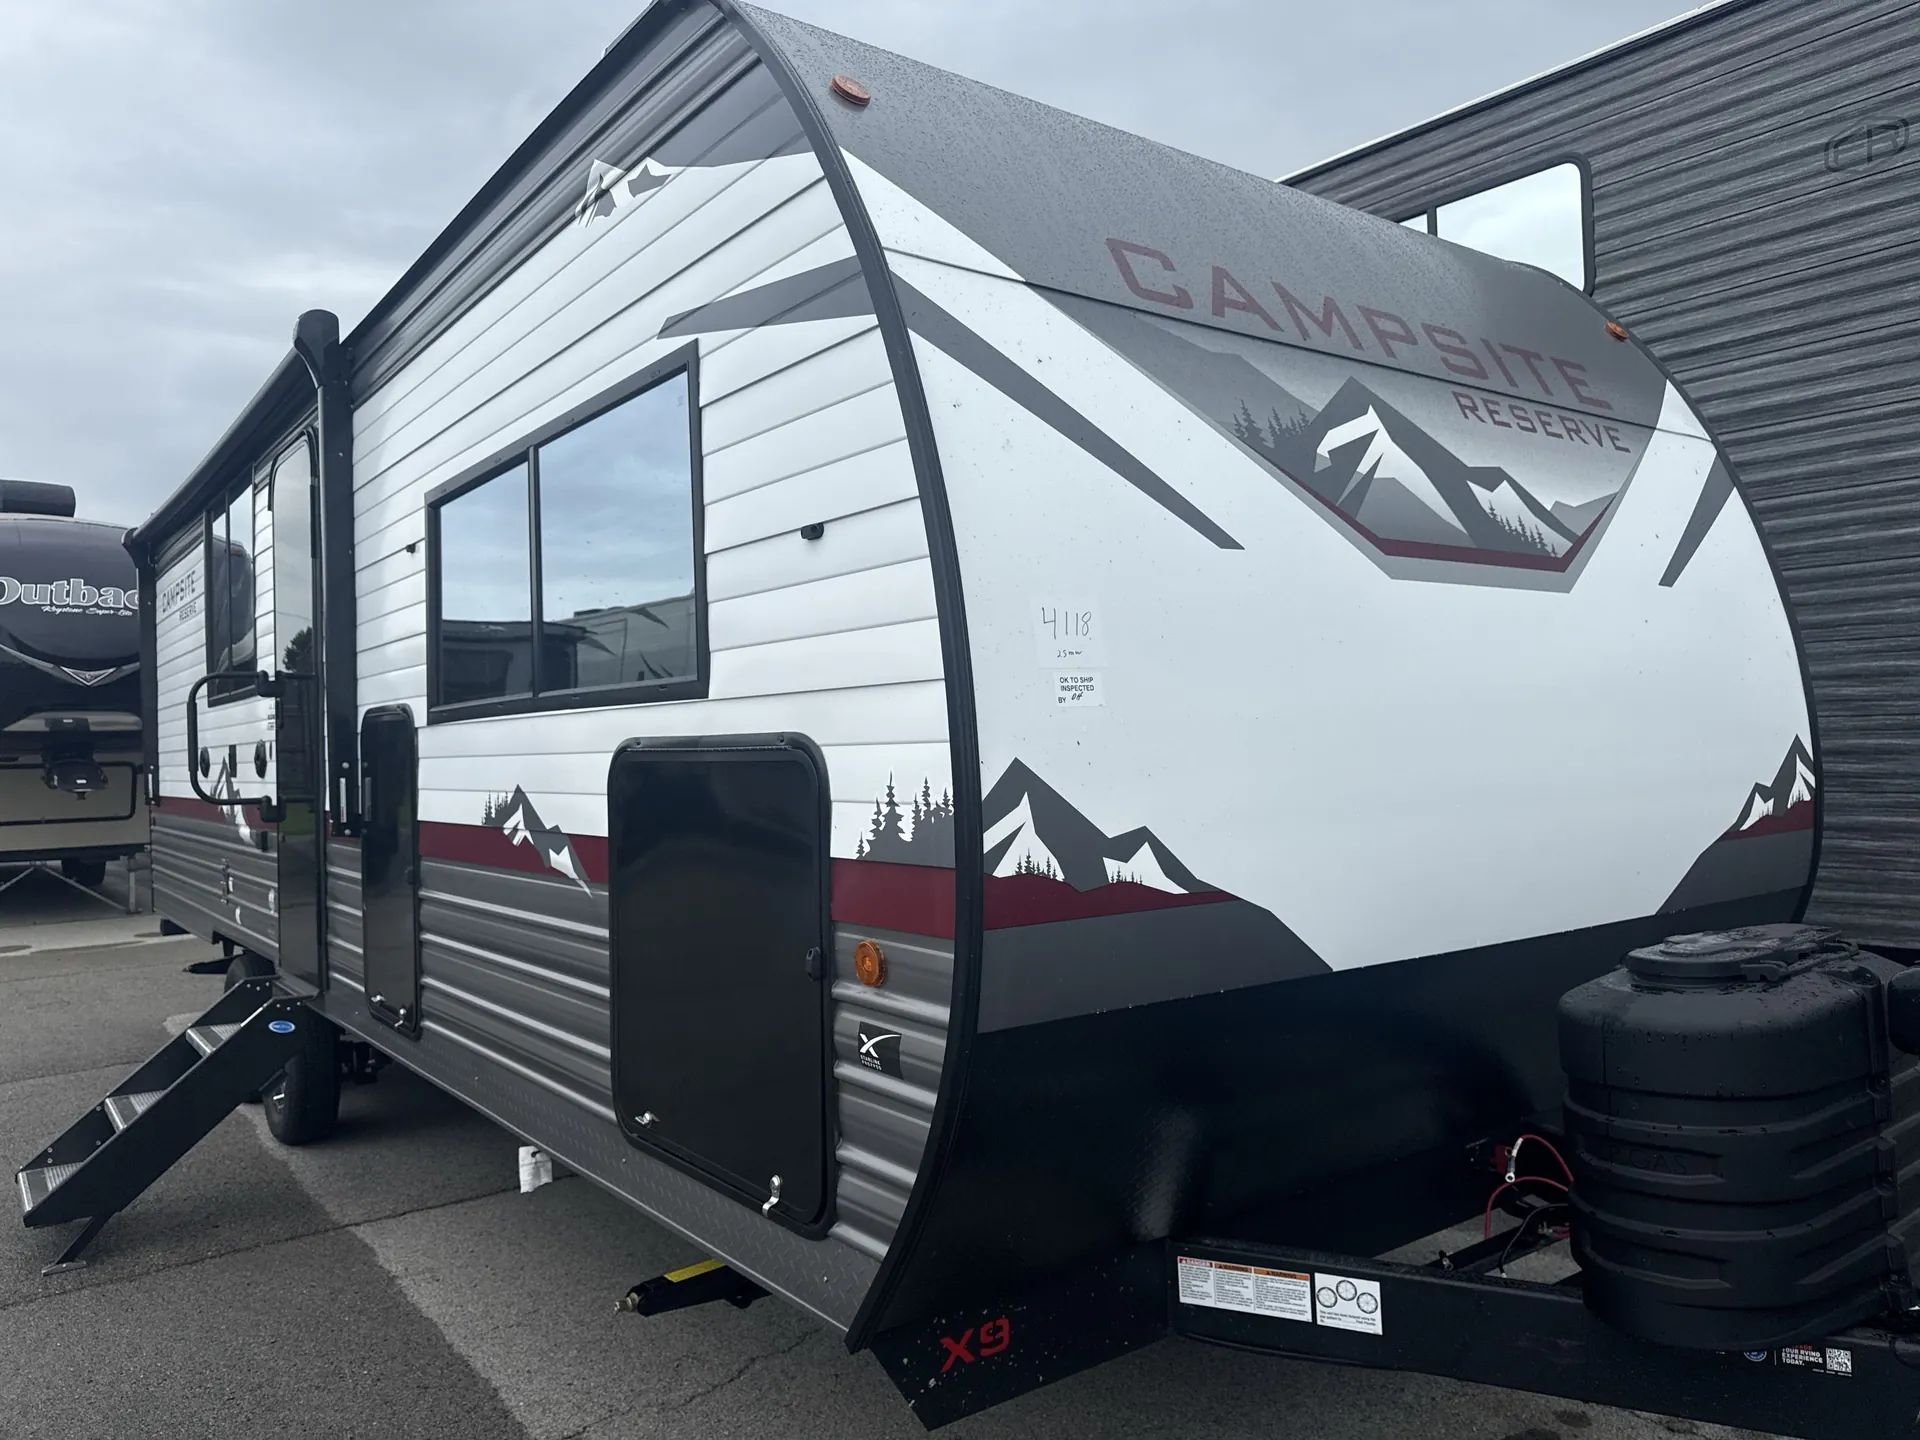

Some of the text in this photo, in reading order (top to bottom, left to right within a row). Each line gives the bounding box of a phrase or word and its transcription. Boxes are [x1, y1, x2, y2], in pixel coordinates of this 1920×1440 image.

[1105, 237, 1615, 411] CAMPSITE
[1451, 390, 1632, 454] RESERVE
[0, 576, 139, 610] Outbac
[162, 570, 196, 614] CAMPSITE
[1041, 606, 1092, 640] 4118
[1059, 676, 1094, 684] OK TO SHIP
[1060, 684, 1095, 692] INSPECTED
[939, 1317, 1011, 1373] X9
[1781, 1352, 1824, 1364] EXPERIENCE
[1781, 1357, 1805, 1366] TODAY.
[1800, 1349, 1821, 1358] RVING
